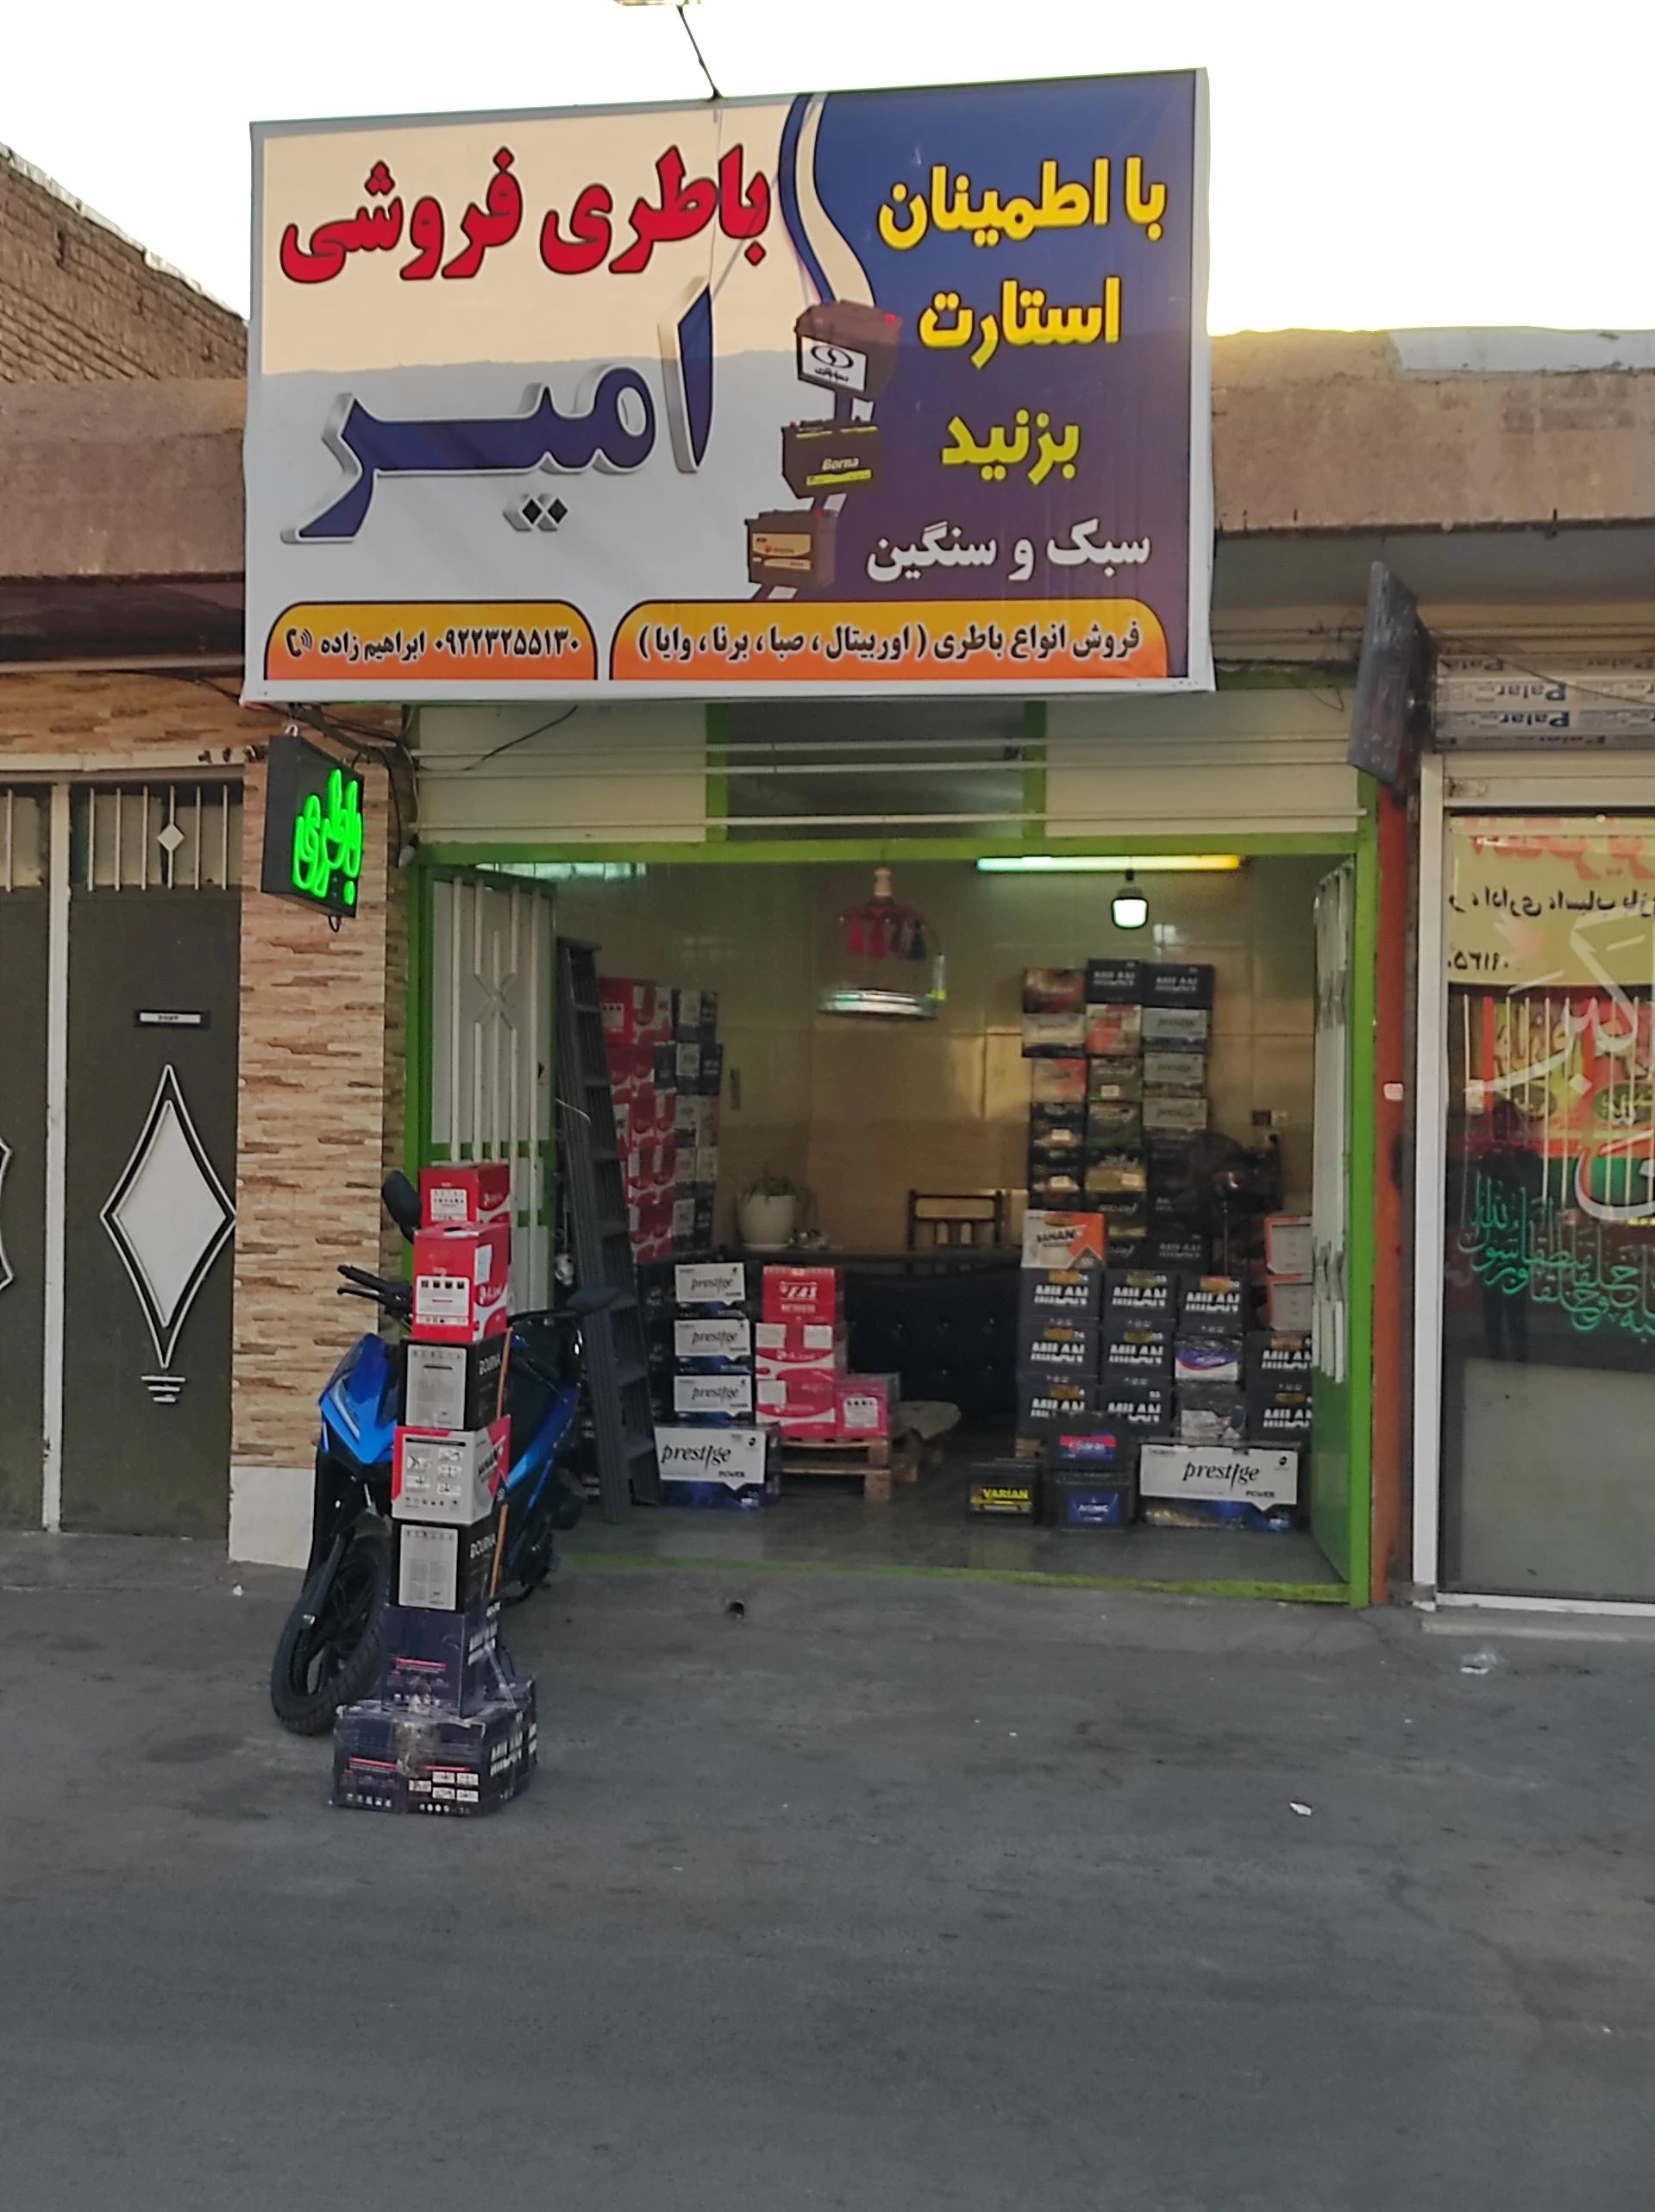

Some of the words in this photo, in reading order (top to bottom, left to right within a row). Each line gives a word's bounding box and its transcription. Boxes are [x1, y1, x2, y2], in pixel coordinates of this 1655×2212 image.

[279, 147, 523, 284] فروشی
[540, 143, 772, 275] باطری
[878, 156, 1109, 250] اطمینان
[1124, 155, 1167, 241] با
[918, 276, 1120, 367] استارت
[285, 283, 714, 542] امیر
[942, 409, 1080, 485] بزنید
[866, 521, 998, 581] سنگین
[1009, 548, 1034, 581] و
[1047, 519, 1150, 578] سبک
[320, 631, 359, 661] زاده
[364, 630, 425, 661] ابراهیم
[436, 628, 580, 655] ۰۹۲۲۳۲۵۵۱۳۰
[933, 623, 1003, 660] باطری
[1010, 623, 1065, 660] انواع
[1073, 620, 1141, 659] فروش
[1496, 683, 1566, 701] Palar
[1500, 711, 1570, 728] Palar
[661, 1444, 731, 1472] prestige
[1182, 1461, 1260, 1492] prestige
[982, 1487, 1029, 1500] VARIAN
[1246, 1489, 1275, 1498] POWER
